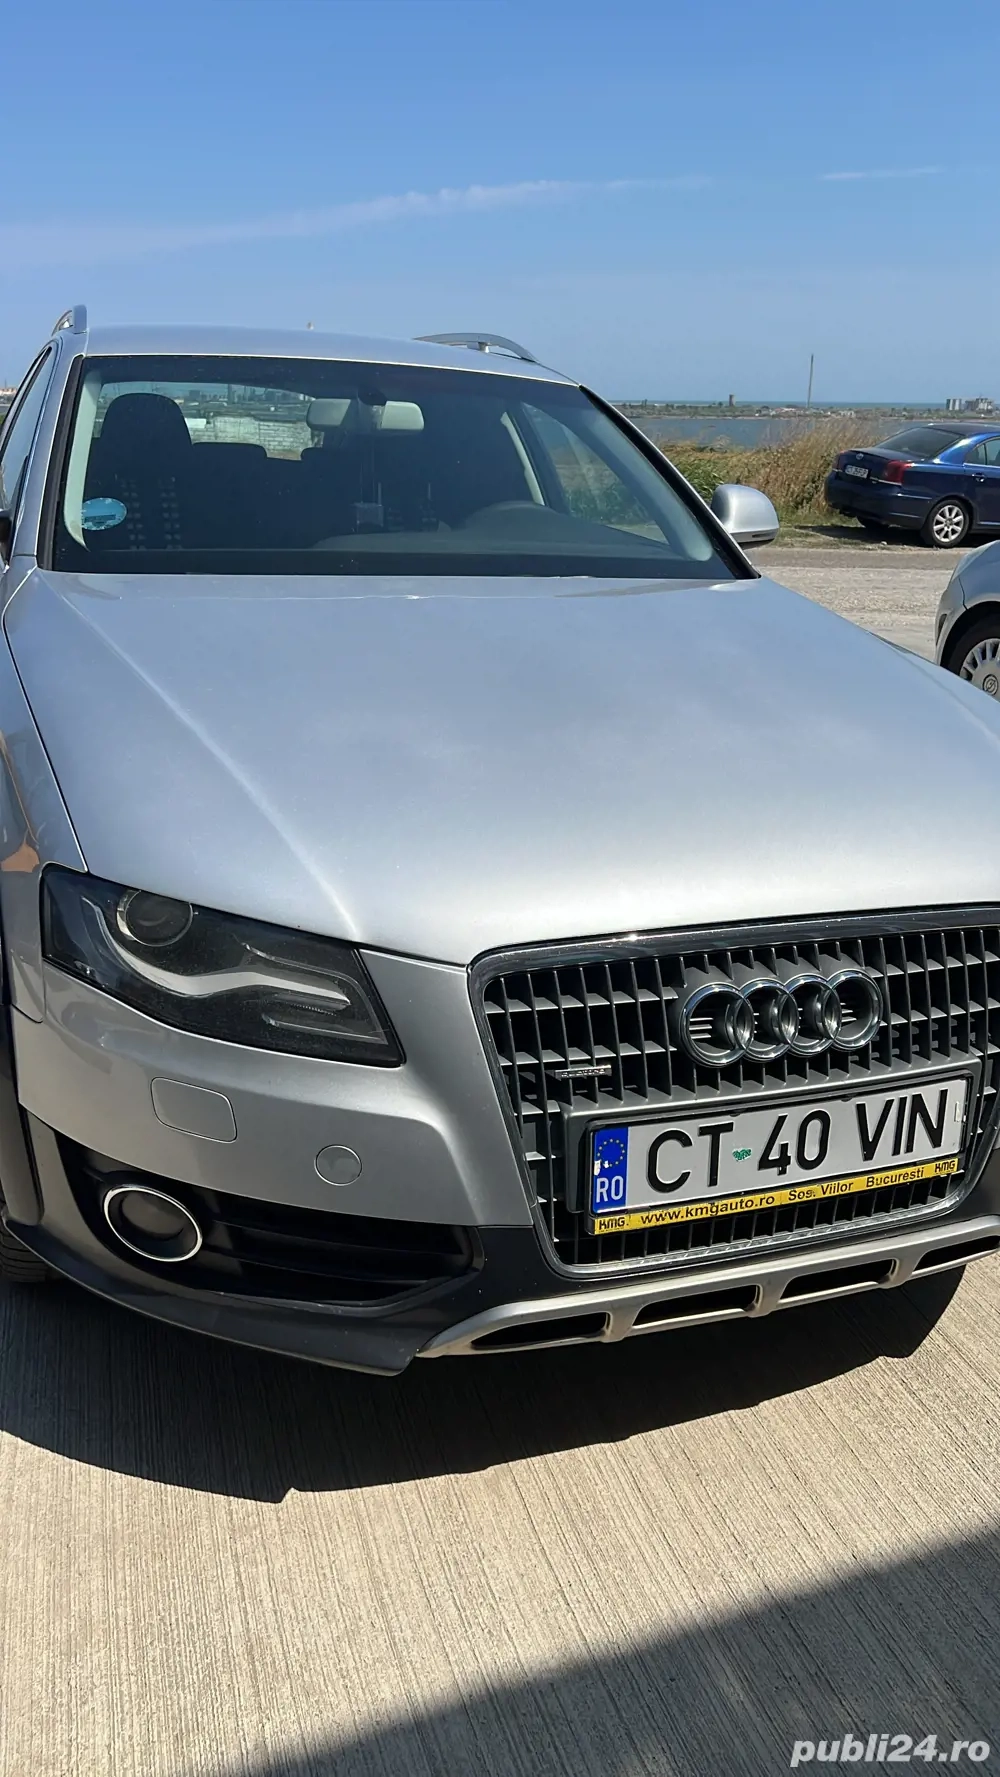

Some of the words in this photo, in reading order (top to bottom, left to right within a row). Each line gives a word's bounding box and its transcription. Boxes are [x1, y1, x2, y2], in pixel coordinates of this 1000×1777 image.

[647, 1121, 734, 1193] CT
[757, 1109, 831, 1176] 40
[856, 1089, 948, 1161] VIN
[596, 1176, 624, 1203] RO
[640, 1195, 775, 1225] www.kmgauto.ro
[821, 1182, 854, 1196] Viilor
[866, 1167, 924, 1187] Bucuresti
[934, 1160, 956, 1173] KMG
